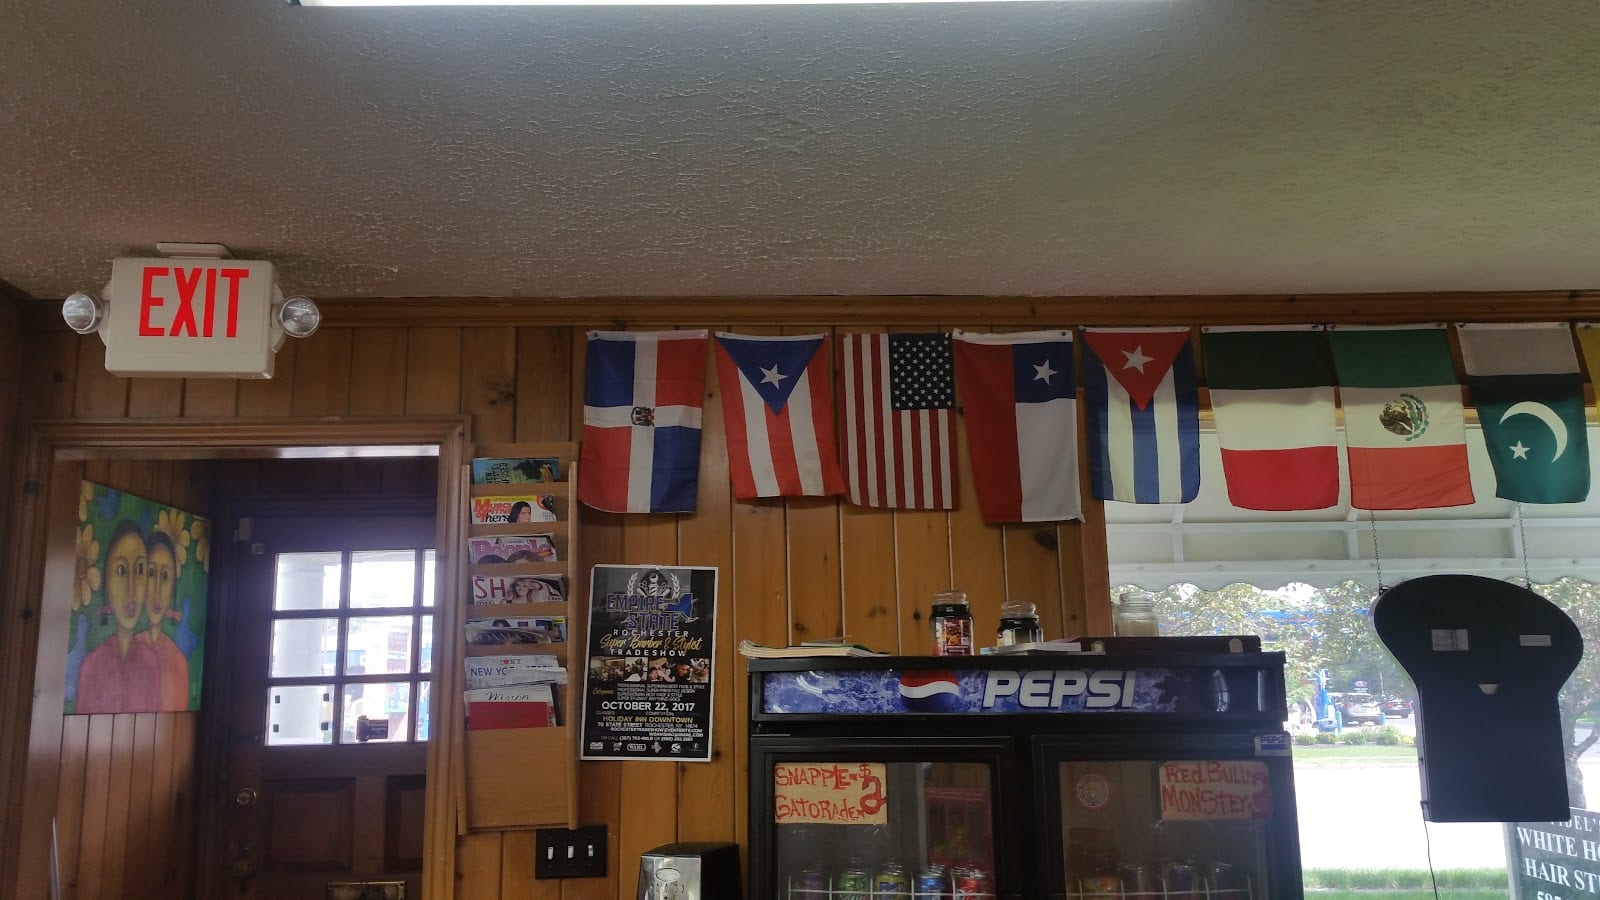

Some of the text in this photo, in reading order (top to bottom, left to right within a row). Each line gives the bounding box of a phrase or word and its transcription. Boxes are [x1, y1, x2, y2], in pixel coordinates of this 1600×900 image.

[139, 267, 249, 338] EXIT
[606, 594, 664, 611] EMPIRE
[628, 612, 680, 630] STATE
[613, 629, 689, 637] ROCHESTER
[600, 634, 626, 648] Super
[627, 634, 661, 649] Barber
[672, 635, 703, 652] Stylist
[471, 667, 492, 676] NEW
[983, 671, 1136, 708] PEPSI
[601, 701, 695, 712] OCTOBER 22, 2017
[1516, 826, 1600, 861] WHITE H
[1525, 857, 1600, 894] HAIR ST
